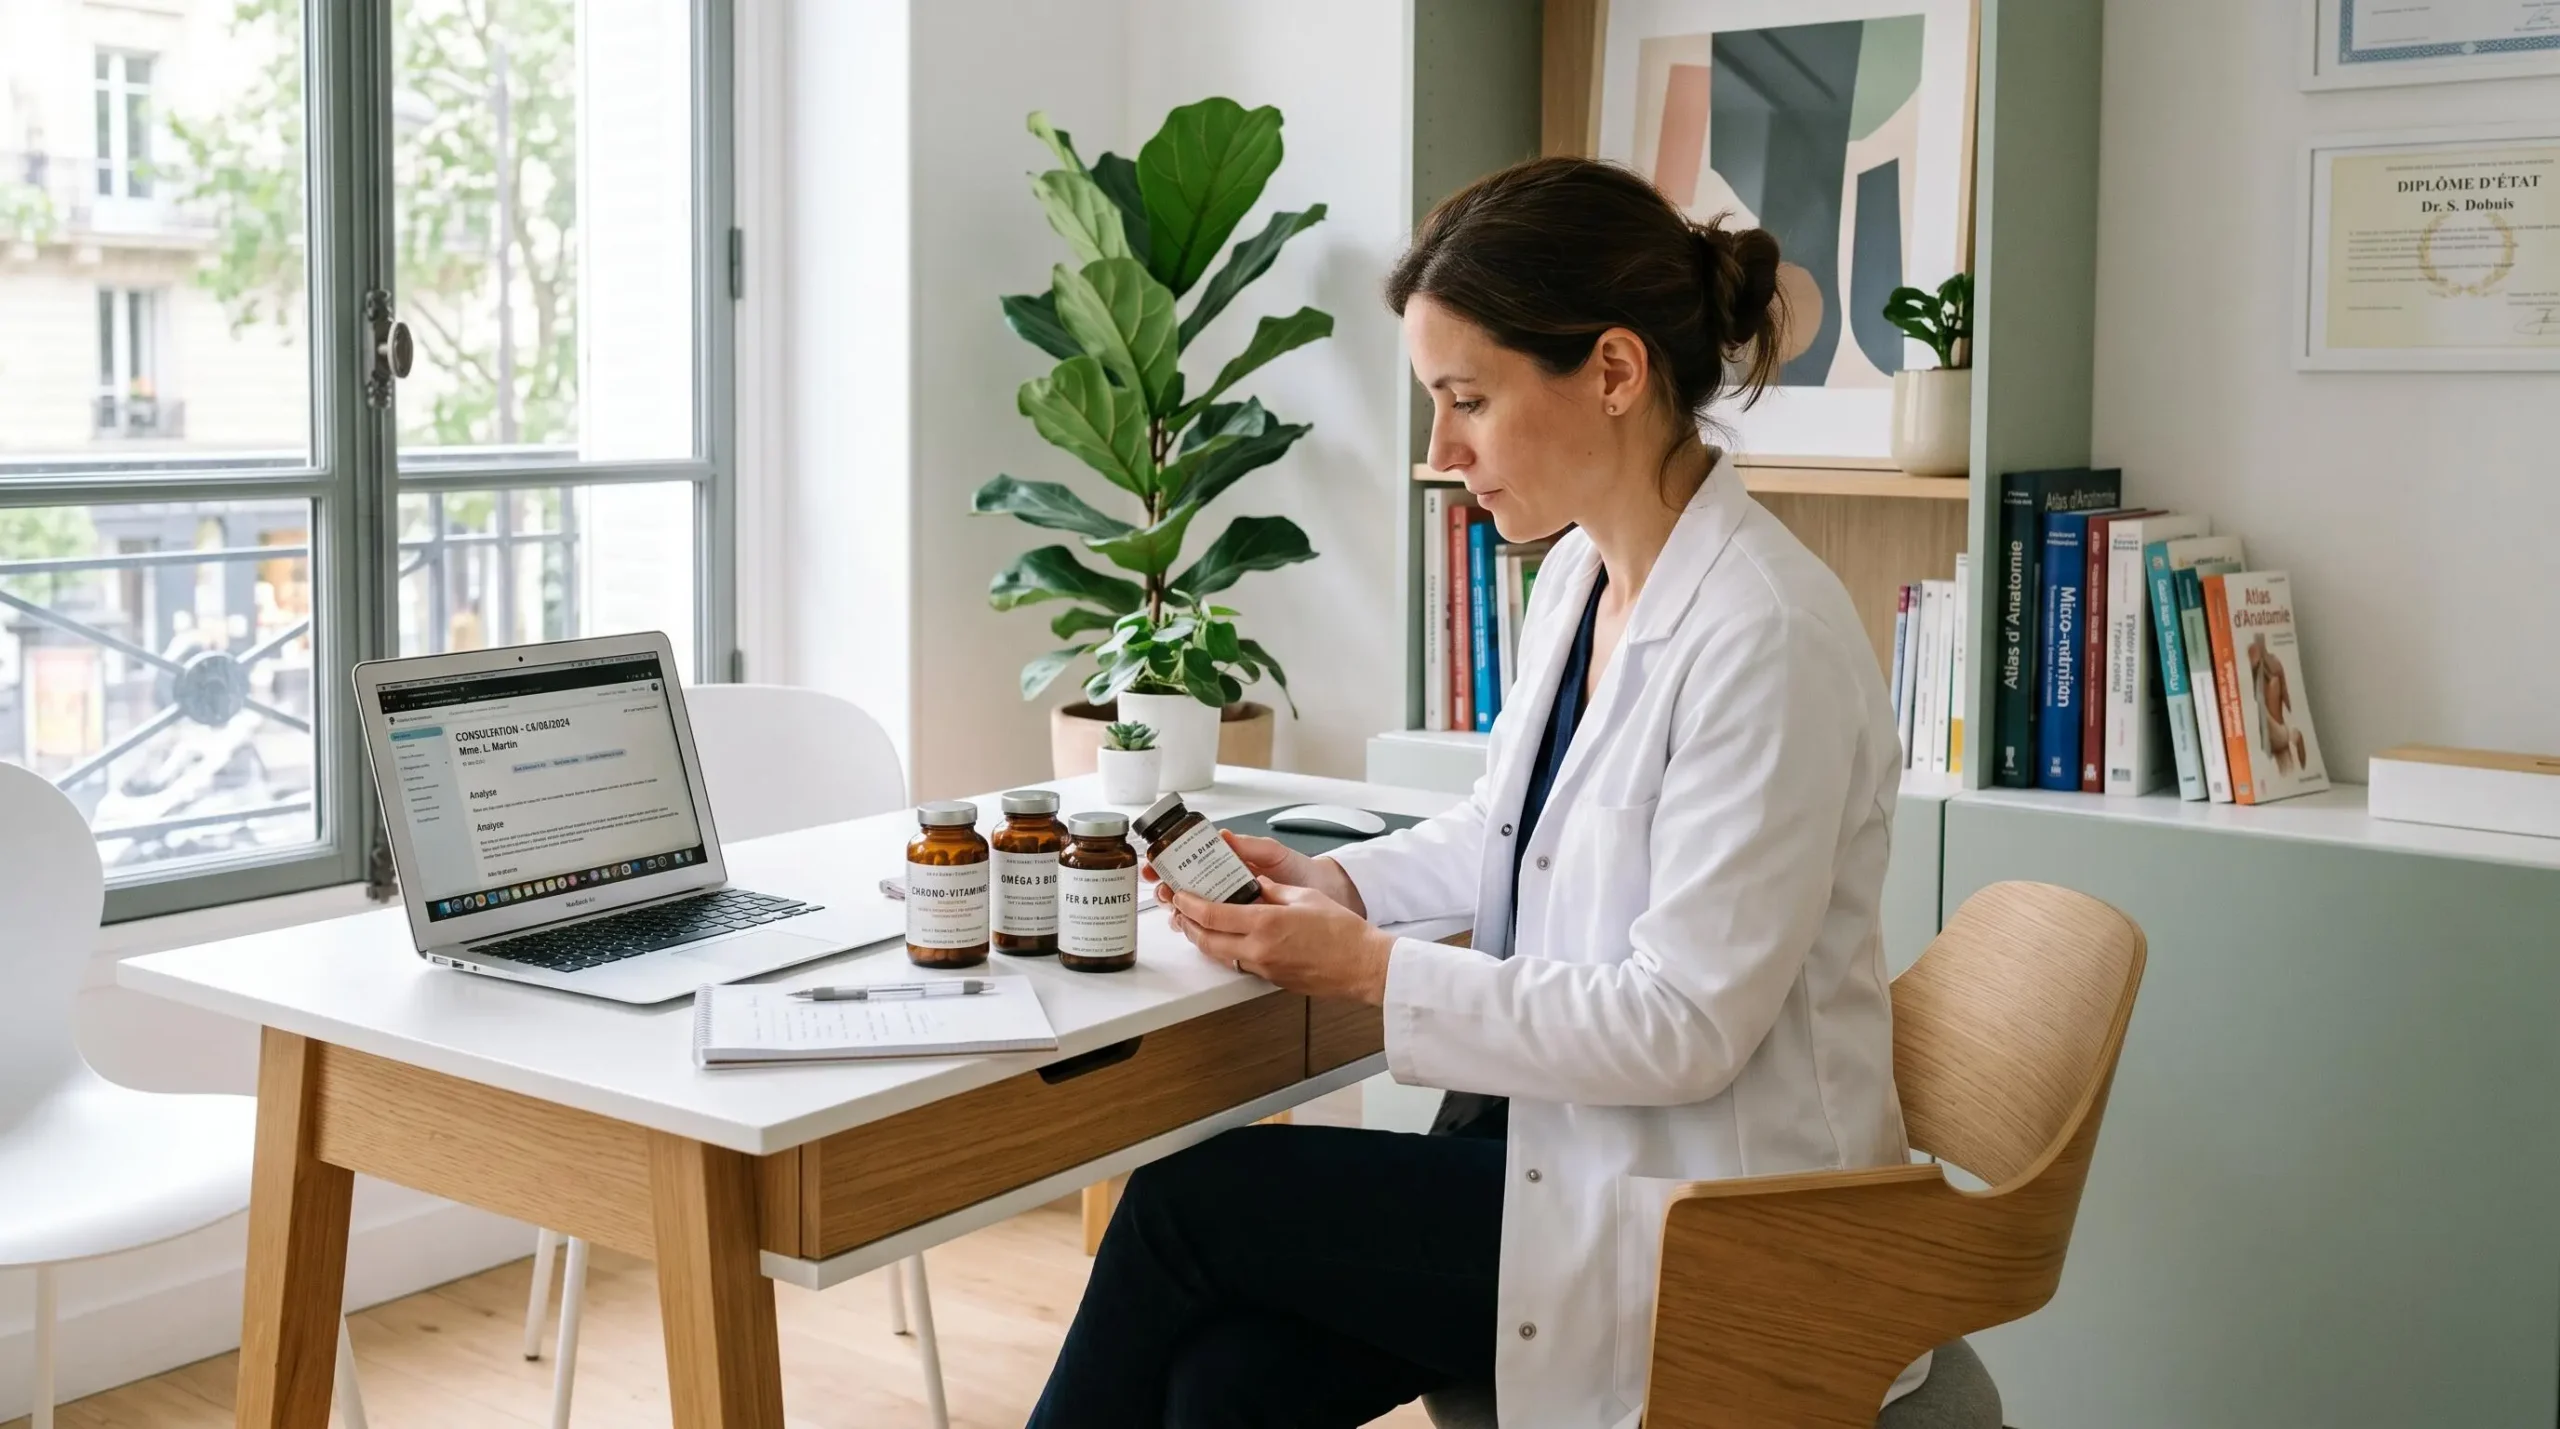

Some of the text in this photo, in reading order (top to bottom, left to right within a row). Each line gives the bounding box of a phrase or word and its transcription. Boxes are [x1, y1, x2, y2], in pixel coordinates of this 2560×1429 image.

[2397, 175, 2474, 193] DIPLÔME
[2421, 200, 2442, 212] Dr.
[2446, 199, 2460, 212] S.
[2245, 587, 2271, 606] Atlas
[2004, 646, 2020, 689] Atlas
[459, 740, 518, 756] Mme. L. Martin
[469, 788, 498, 800] Analyse
[1001, 874, 1057, 885] OMÉGA 3 BIO
[1065, 893, 1131, 905] FER & PLANTES
